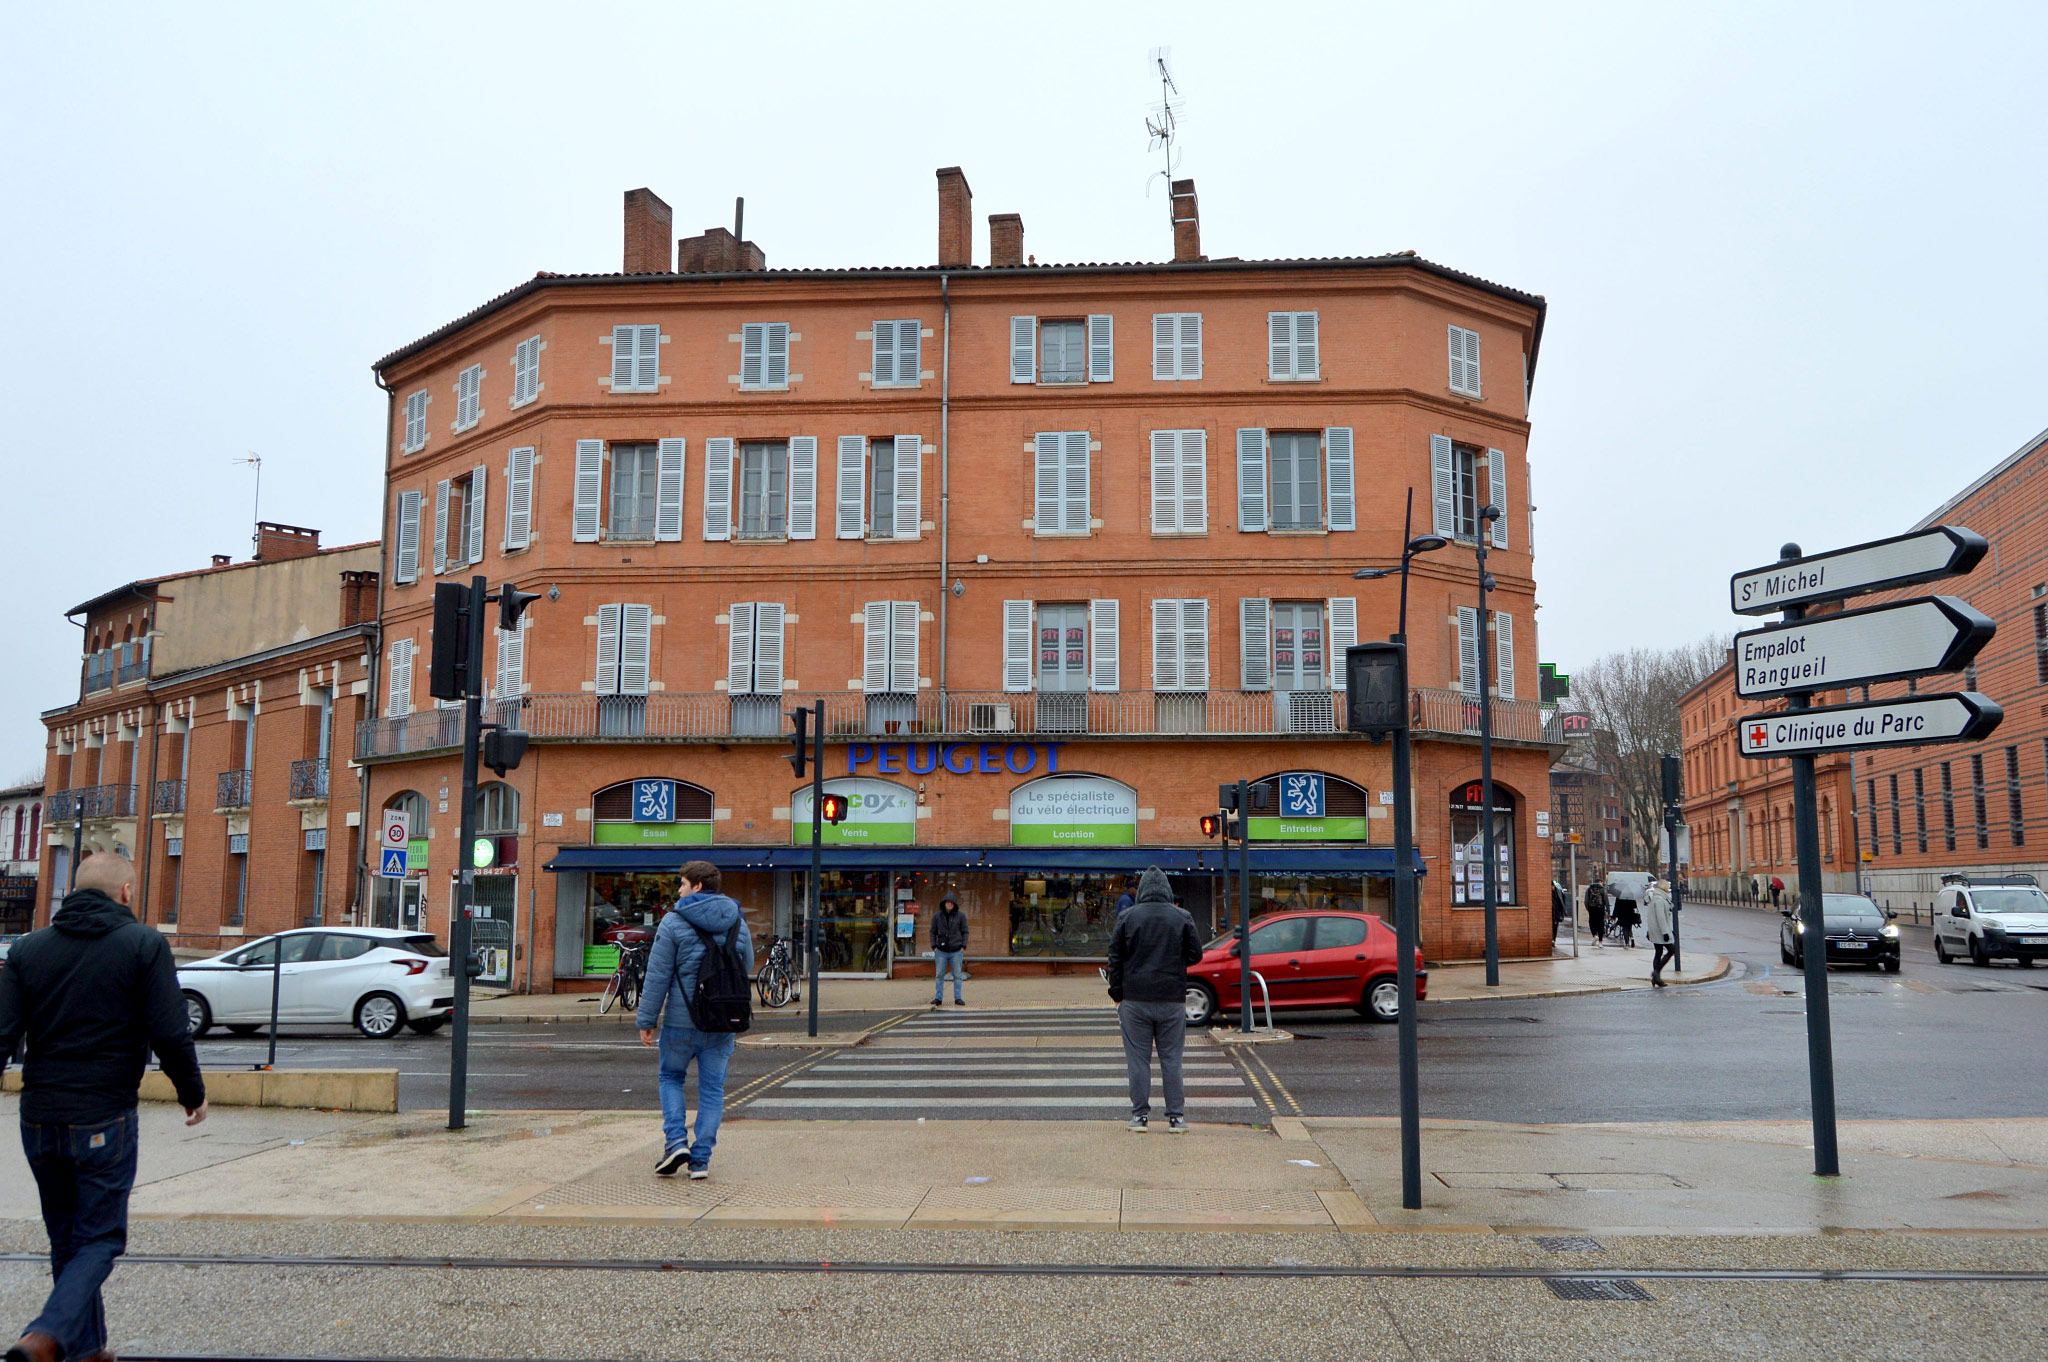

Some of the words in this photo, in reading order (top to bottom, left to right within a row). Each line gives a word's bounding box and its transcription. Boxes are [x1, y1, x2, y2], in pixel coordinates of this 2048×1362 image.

[1765, 567, 1825, 598] Michel
[1745, 635, 1806, 663] Empalot
[1745, 656, 1826, 687] Rangueil
[1354, 701, 1398, 717] STOP
[1563, 715, 1589, 730] FIT
[1775, 721, 1846, 745] Clinique
[1853, 717, 1875, 737] du
[1881, 713, 1925, 734] Parc
[847, 741, 1067, 775] PEUGEOT
[1028, 791, 1044, 802] Le
[1047, 790, 1115, 803] spécialiste
[1017, 804, 1033, 815] du
[1037, 804, 1063, 815] vélo
[1066, 804, 1130, 816] électrique
[390, 814, 405, 822] ZONE
[391, 829, 402, 838] 30
[643, 829, 668, 837] Essai
[841, 829, 868, 837] Vente
[1053, 830, 1095, 838] Location
[1280, 824, 1324, 833] Entretien
[409, 845, 423, 854] TEUR
[0, 877, 35, 888] VERNE
[0, 888, 27, 898] ROLL
